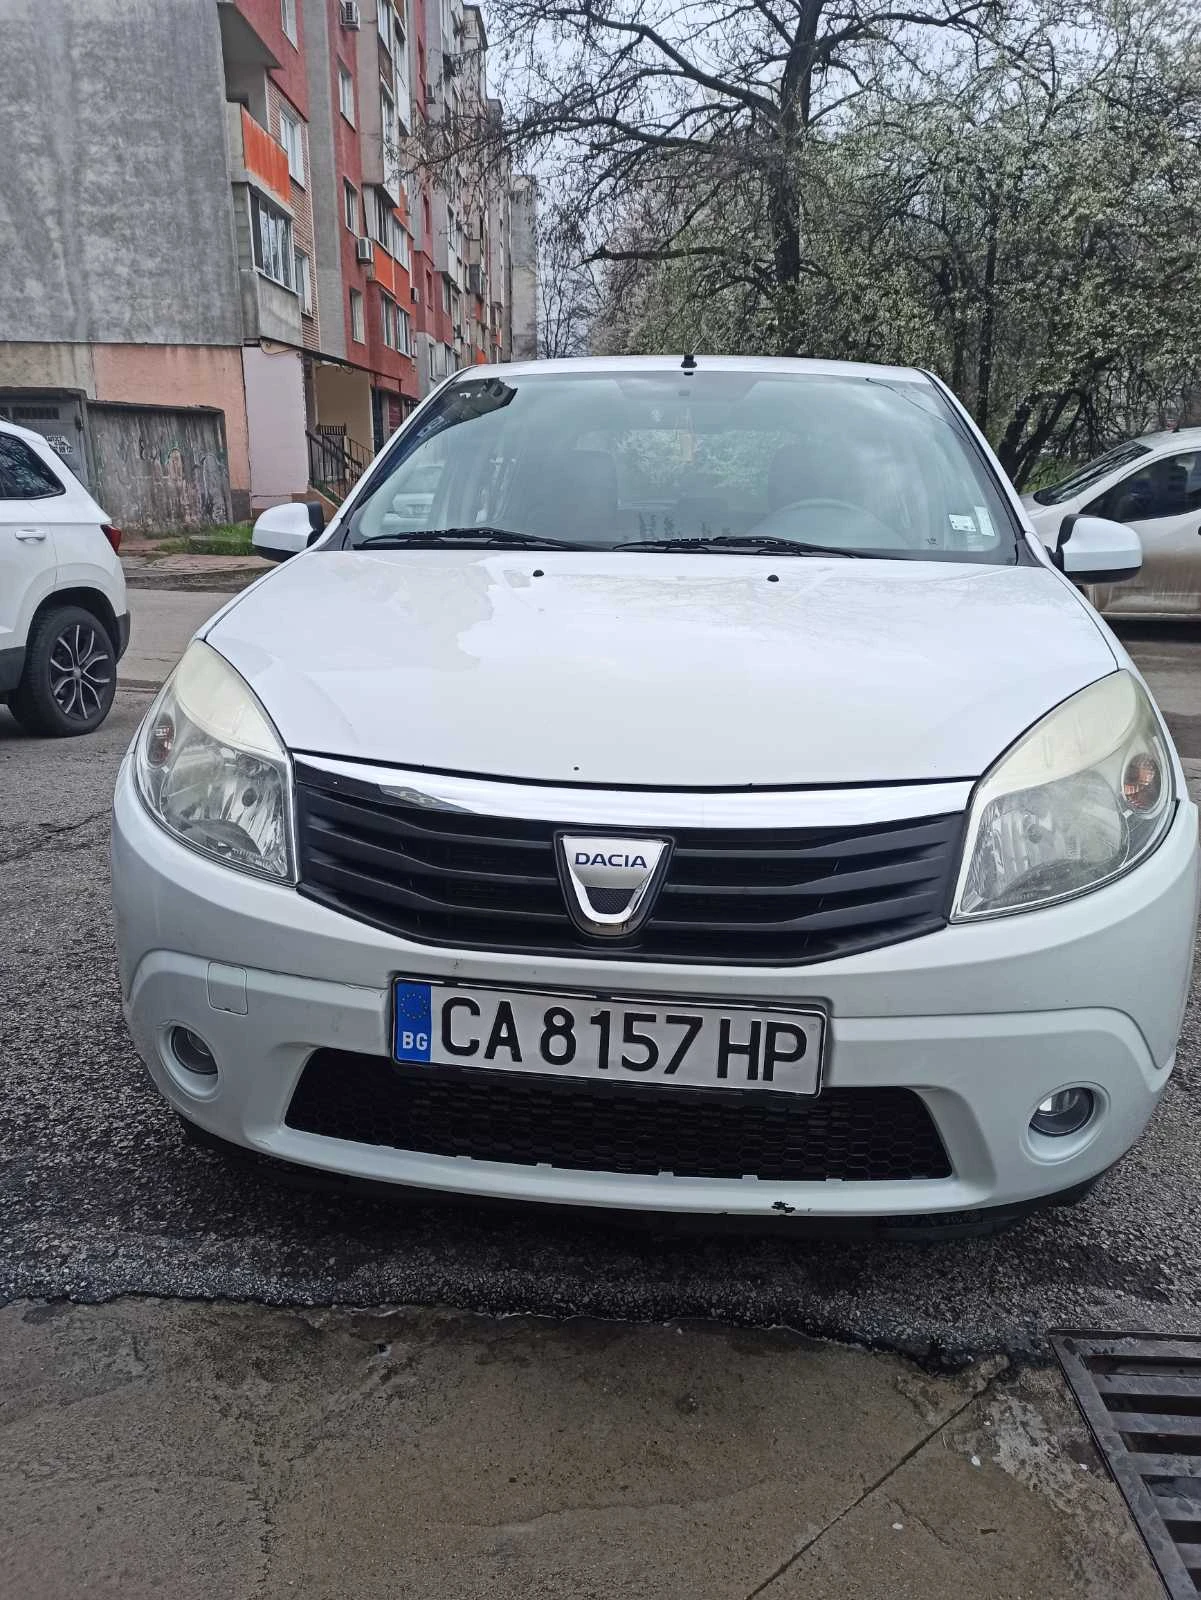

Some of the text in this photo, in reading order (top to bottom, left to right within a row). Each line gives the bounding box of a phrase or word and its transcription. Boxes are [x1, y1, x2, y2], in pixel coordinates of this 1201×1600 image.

[575, 853, 647, 868] DACIA
[402, 1032, 428, 1050] BG
[441, 997, 807, 1081] CA 8157 HP
